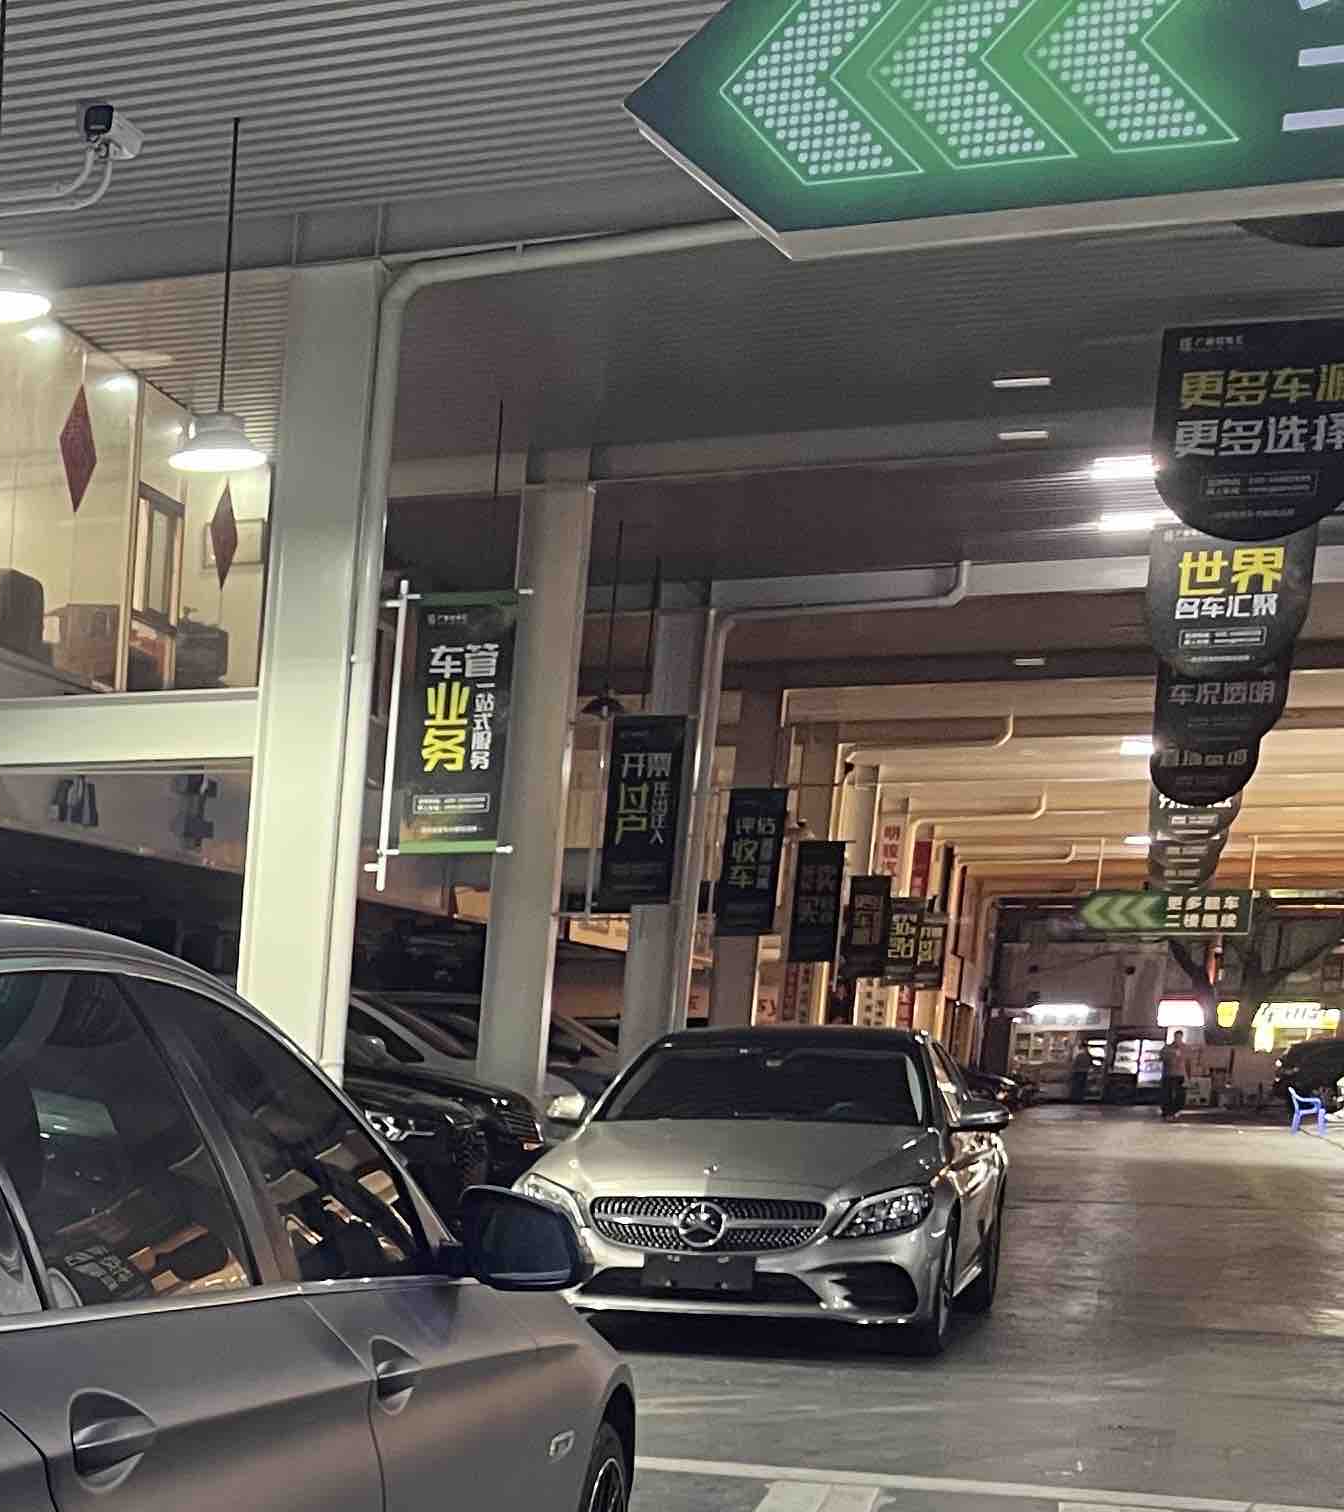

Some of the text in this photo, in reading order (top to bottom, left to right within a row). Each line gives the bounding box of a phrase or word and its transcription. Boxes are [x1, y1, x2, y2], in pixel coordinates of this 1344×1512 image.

[1177, 545, 1286, 597] 世界
[429, 642, 499, 679] 车管
[421, 681, 471, 773] 业务
